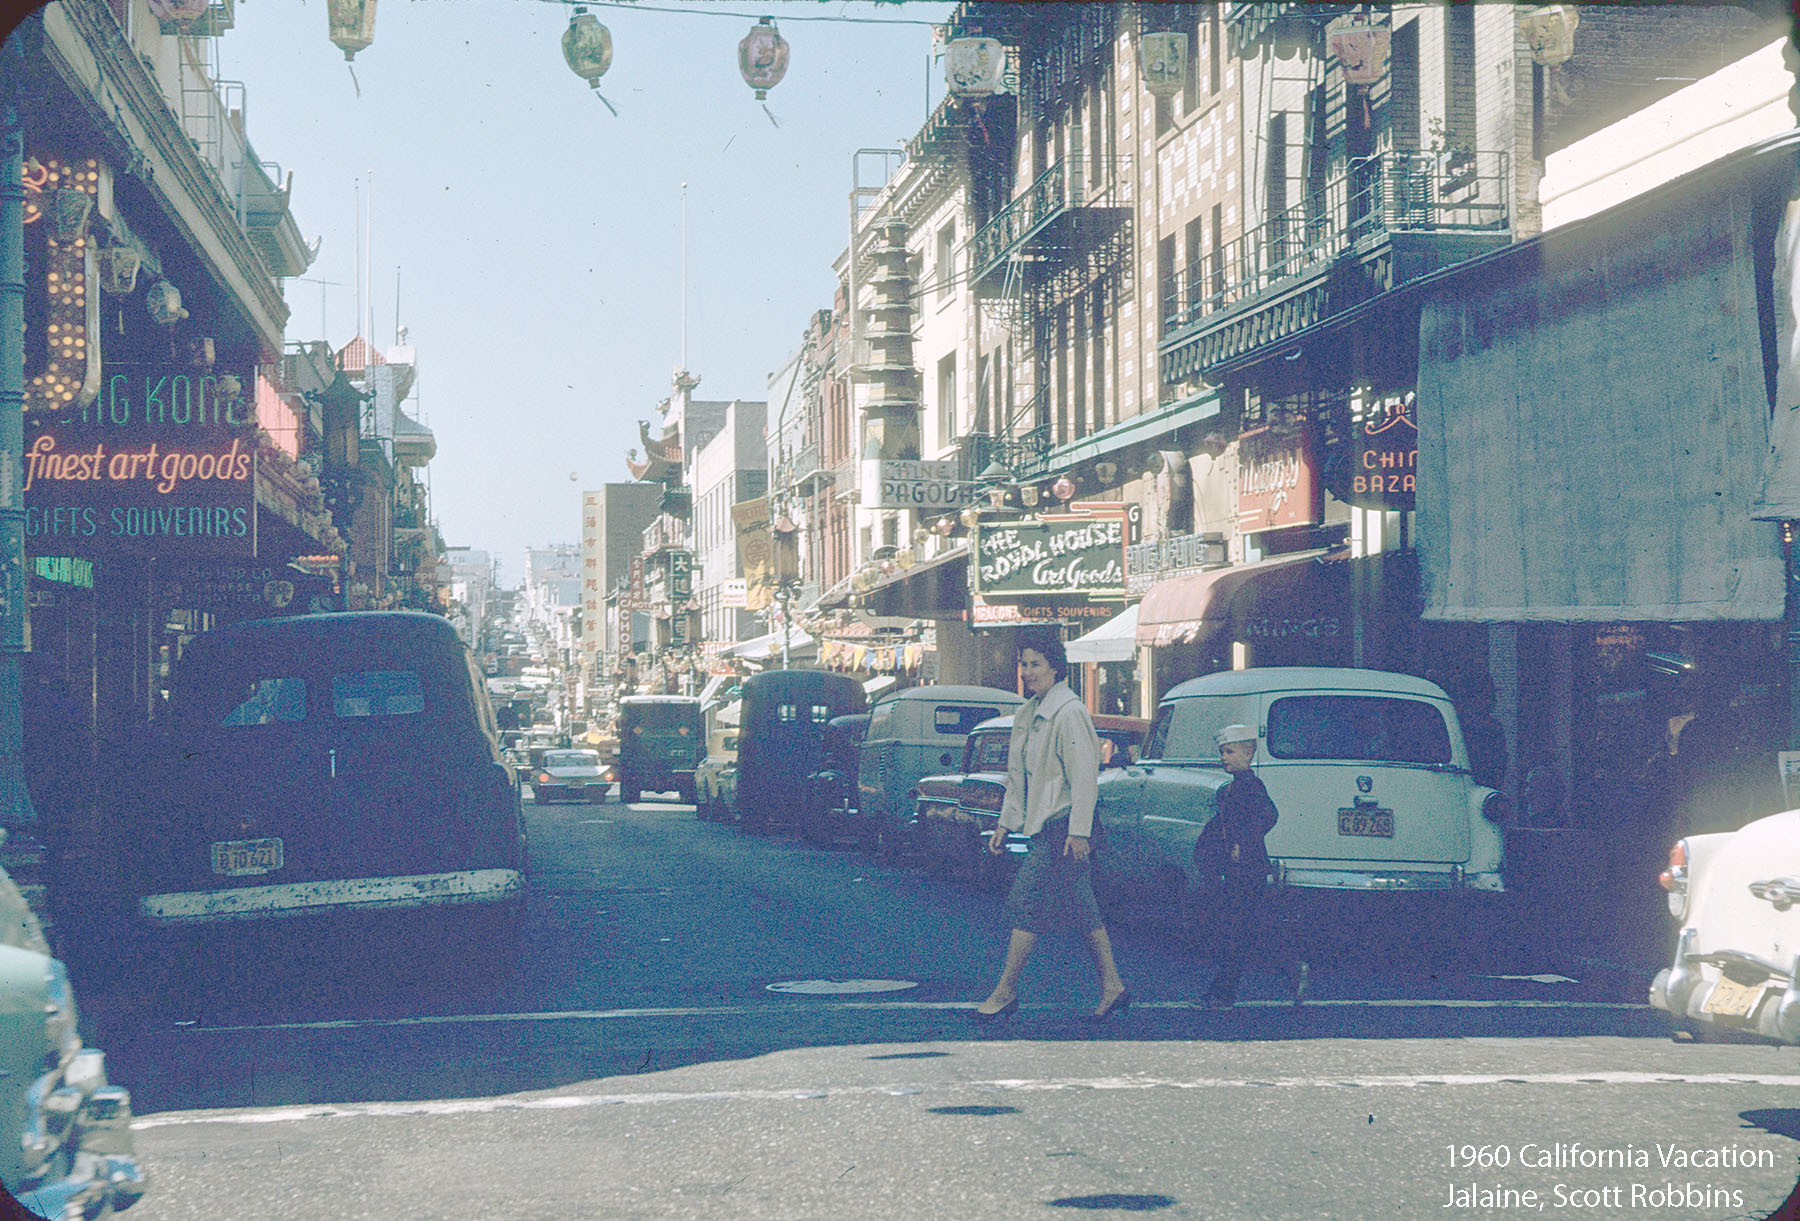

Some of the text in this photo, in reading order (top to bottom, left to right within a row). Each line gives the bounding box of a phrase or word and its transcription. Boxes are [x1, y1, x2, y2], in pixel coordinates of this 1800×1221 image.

[23, 436, 250, 493] finest art goods
[881, 482, 975, 504] PAGODA
[26, 507, 248, 537] GIFTS SOUVENIRS
[980, 530, 1021, 555] THE
[980, 522, 1121, 583] ROYAL HOUSE
[1032, 558, 1066, 585] Art
[1066, 557, 1123, 591] Goods
[1023, 607, 1053, 617] GIFTS
[1057, 606, 1112, 617] SOUVENIRS
